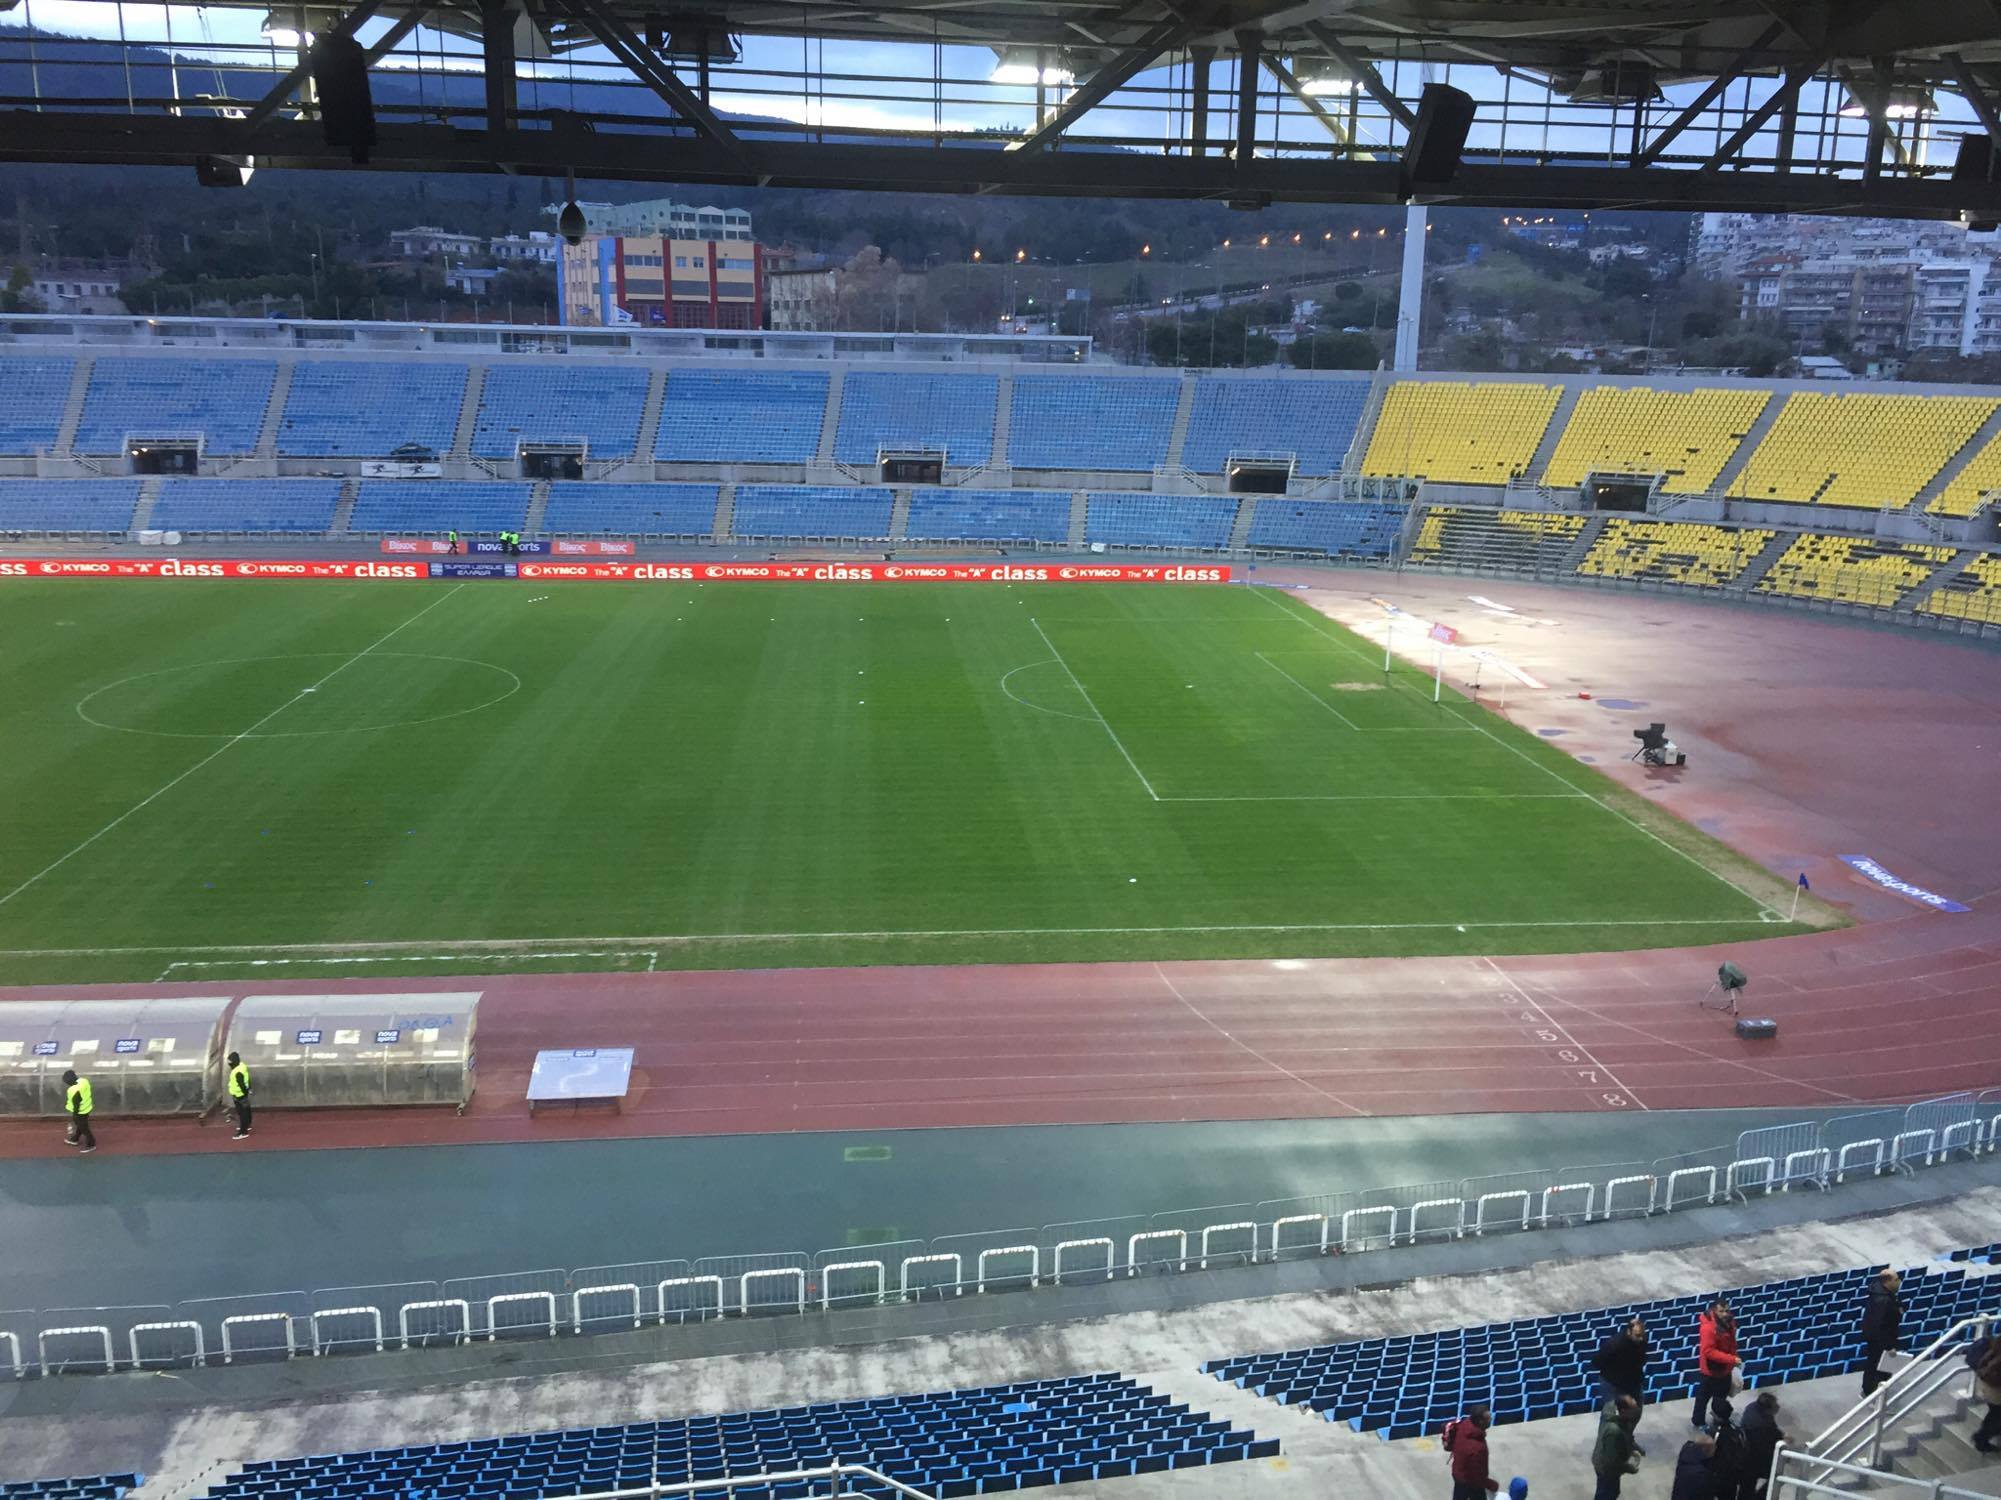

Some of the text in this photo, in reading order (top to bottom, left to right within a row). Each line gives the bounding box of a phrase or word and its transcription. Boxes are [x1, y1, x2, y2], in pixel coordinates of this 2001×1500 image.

[62, 563, 111, 573] KYMCO
[160, 560, 225, 577] class
[259, 564, 306, 573] KYMCO
[354, 562, 417, 577] class
[542, 566, 588, 575] KYMCO
[633, 563, 694, 579] class
[726, 567, 770, 576] KYMCO
[814, 564, 873, 580] class
[904, 568, 948, 577] KYMCO
[991, 565, 1048, 581] class
[1079, 568, 1121, 578] KYMCO
[1164, 565, 1221, 582] class
[1602, 1092, 1628, 1107] 8
